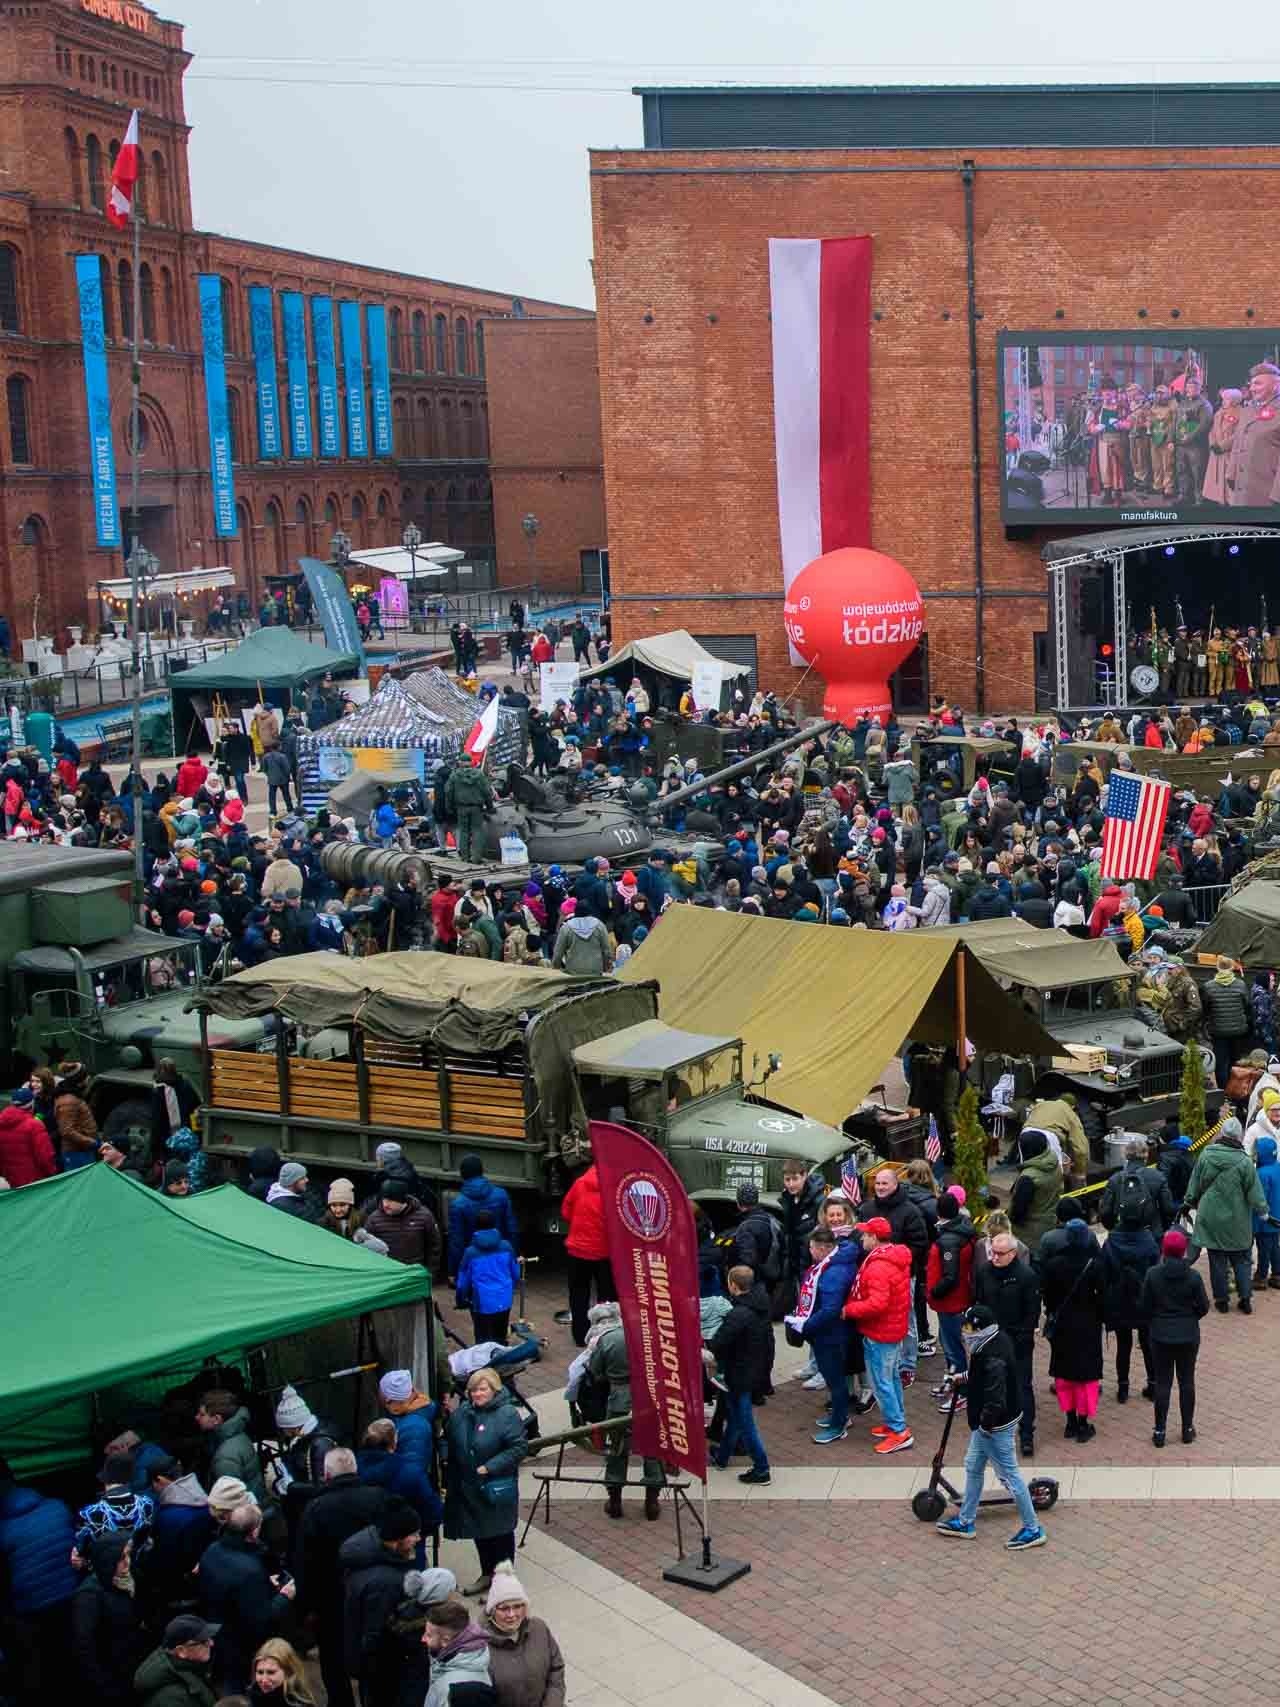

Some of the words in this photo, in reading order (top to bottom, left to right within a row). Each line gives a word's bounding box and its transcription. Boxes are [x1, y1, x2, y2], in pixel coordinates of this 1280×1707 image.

[127, 6, 149, 33] CITY
[261, 384, 273, 408] CITY
[293, 384, 305, 409] CITY
[1120, 511, 1178, 520] manufaktura
[705, 1136, 723, 1151] USA
